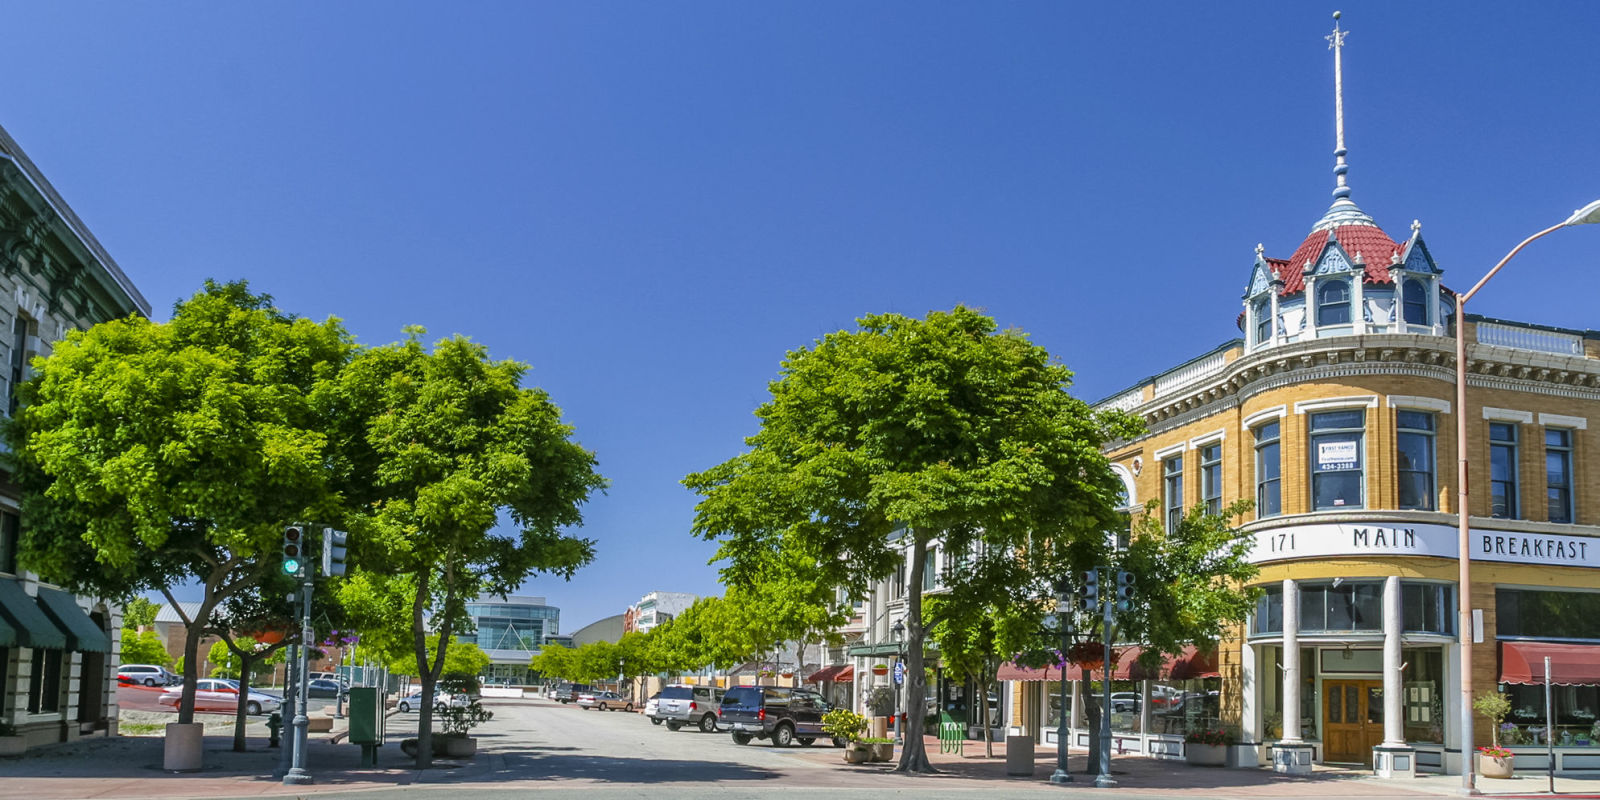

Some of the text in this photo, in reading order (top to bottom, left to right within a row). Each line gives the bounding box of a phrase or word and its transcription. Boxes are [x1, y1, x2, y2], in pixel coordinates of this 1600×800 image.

[1271, 533, 1295, 552] 171
[1353, 528, 1416, 548] MAIN
[1482, 535, 1588, 560] BREAKFAST
